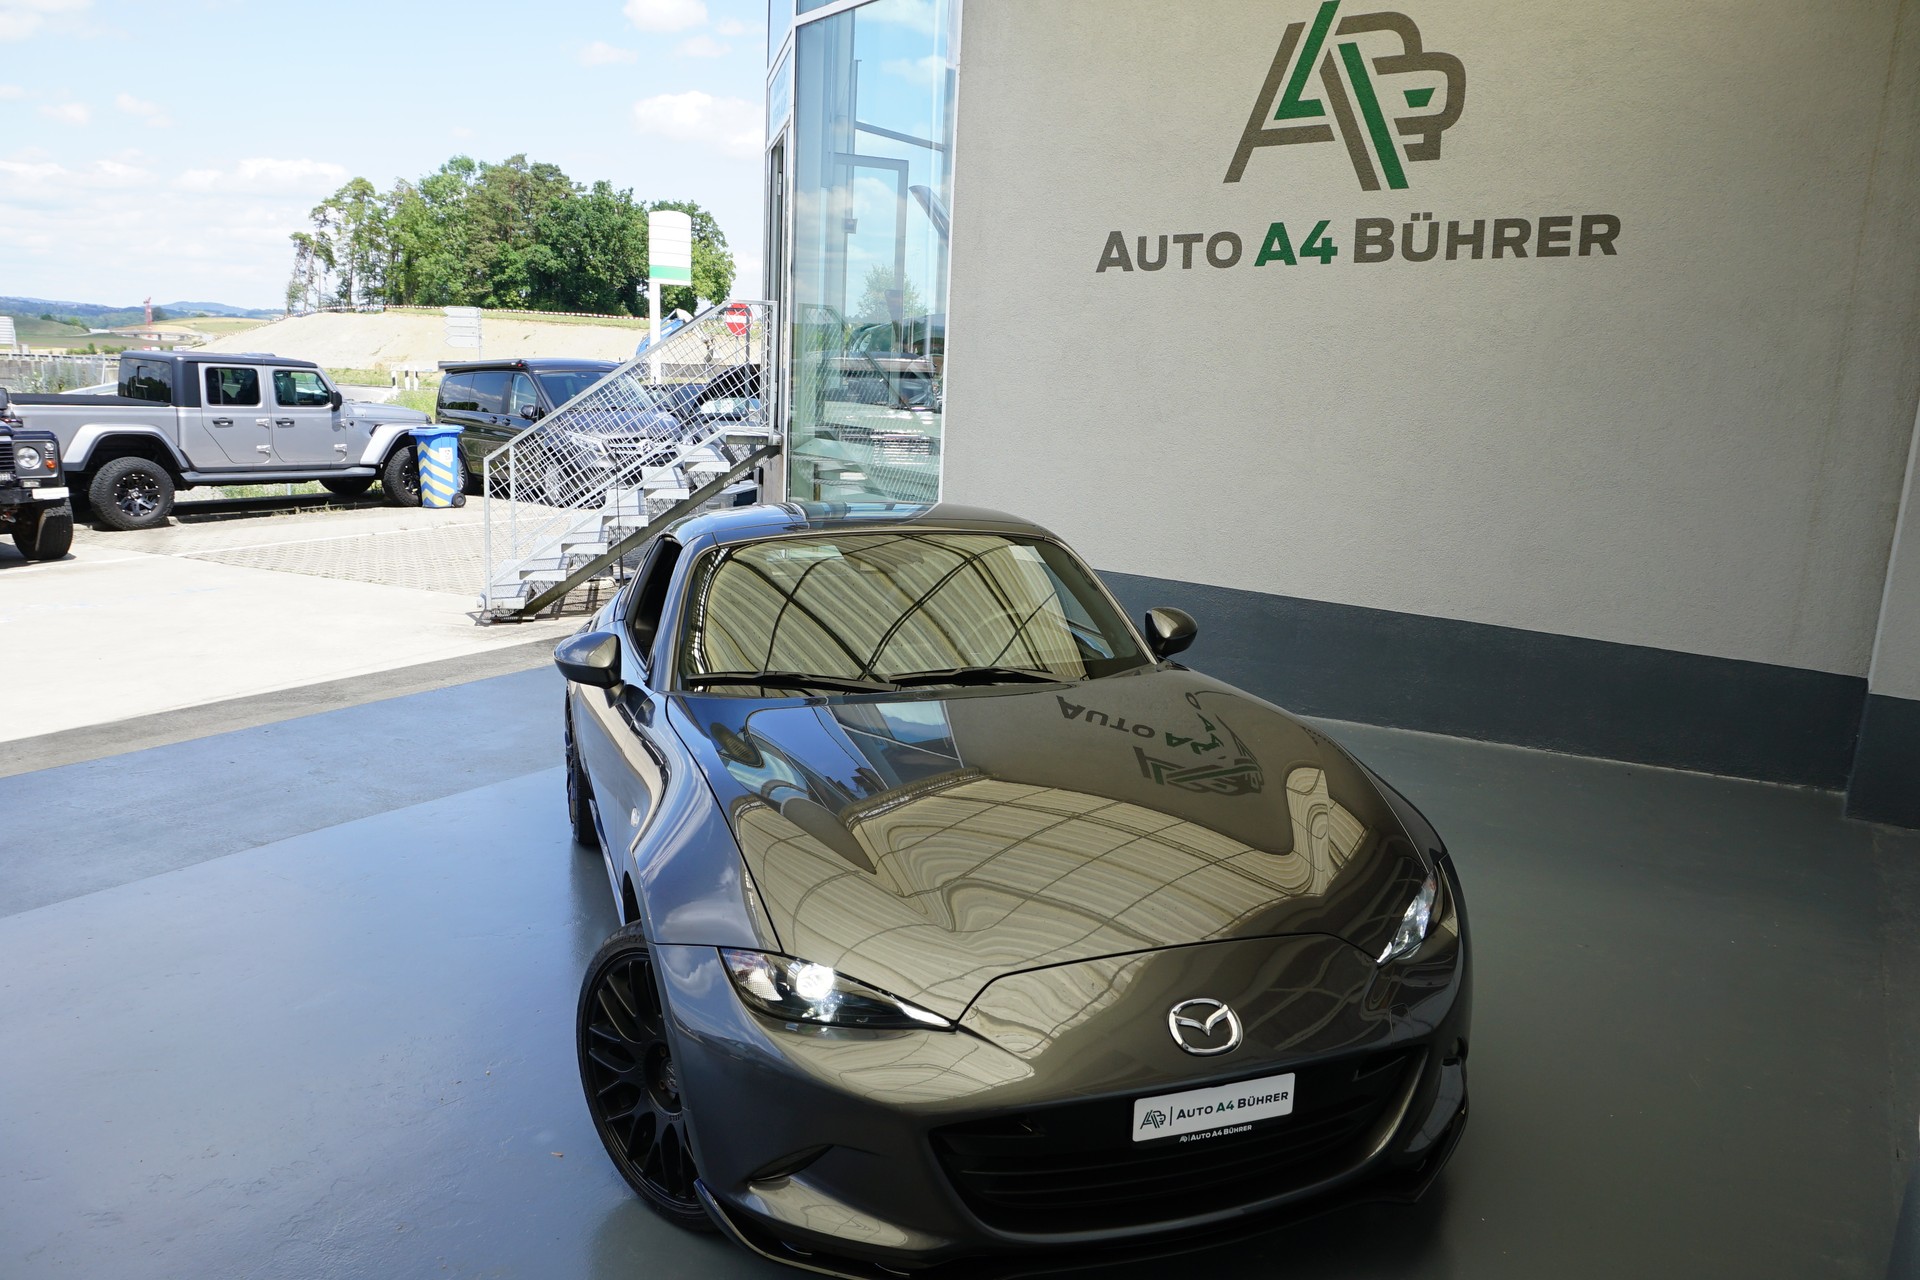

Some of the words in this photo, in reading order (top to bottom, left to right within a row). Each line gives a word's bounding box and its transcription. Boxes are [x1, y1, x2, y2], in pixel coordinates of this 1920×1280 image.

[1095, 230, 1243, 273] AUTO
[1253, 219, 1339, 268] A4
[1353, 212, 1621, 263] BÜHRER
[1176, 1105, 1213, 1119] AUTO
[1216, 1100, 1235, 1113] A4
[1237, 1091, 1289, 1109] BÜHRER
[1212, 1129, 1222, 1138] A4
